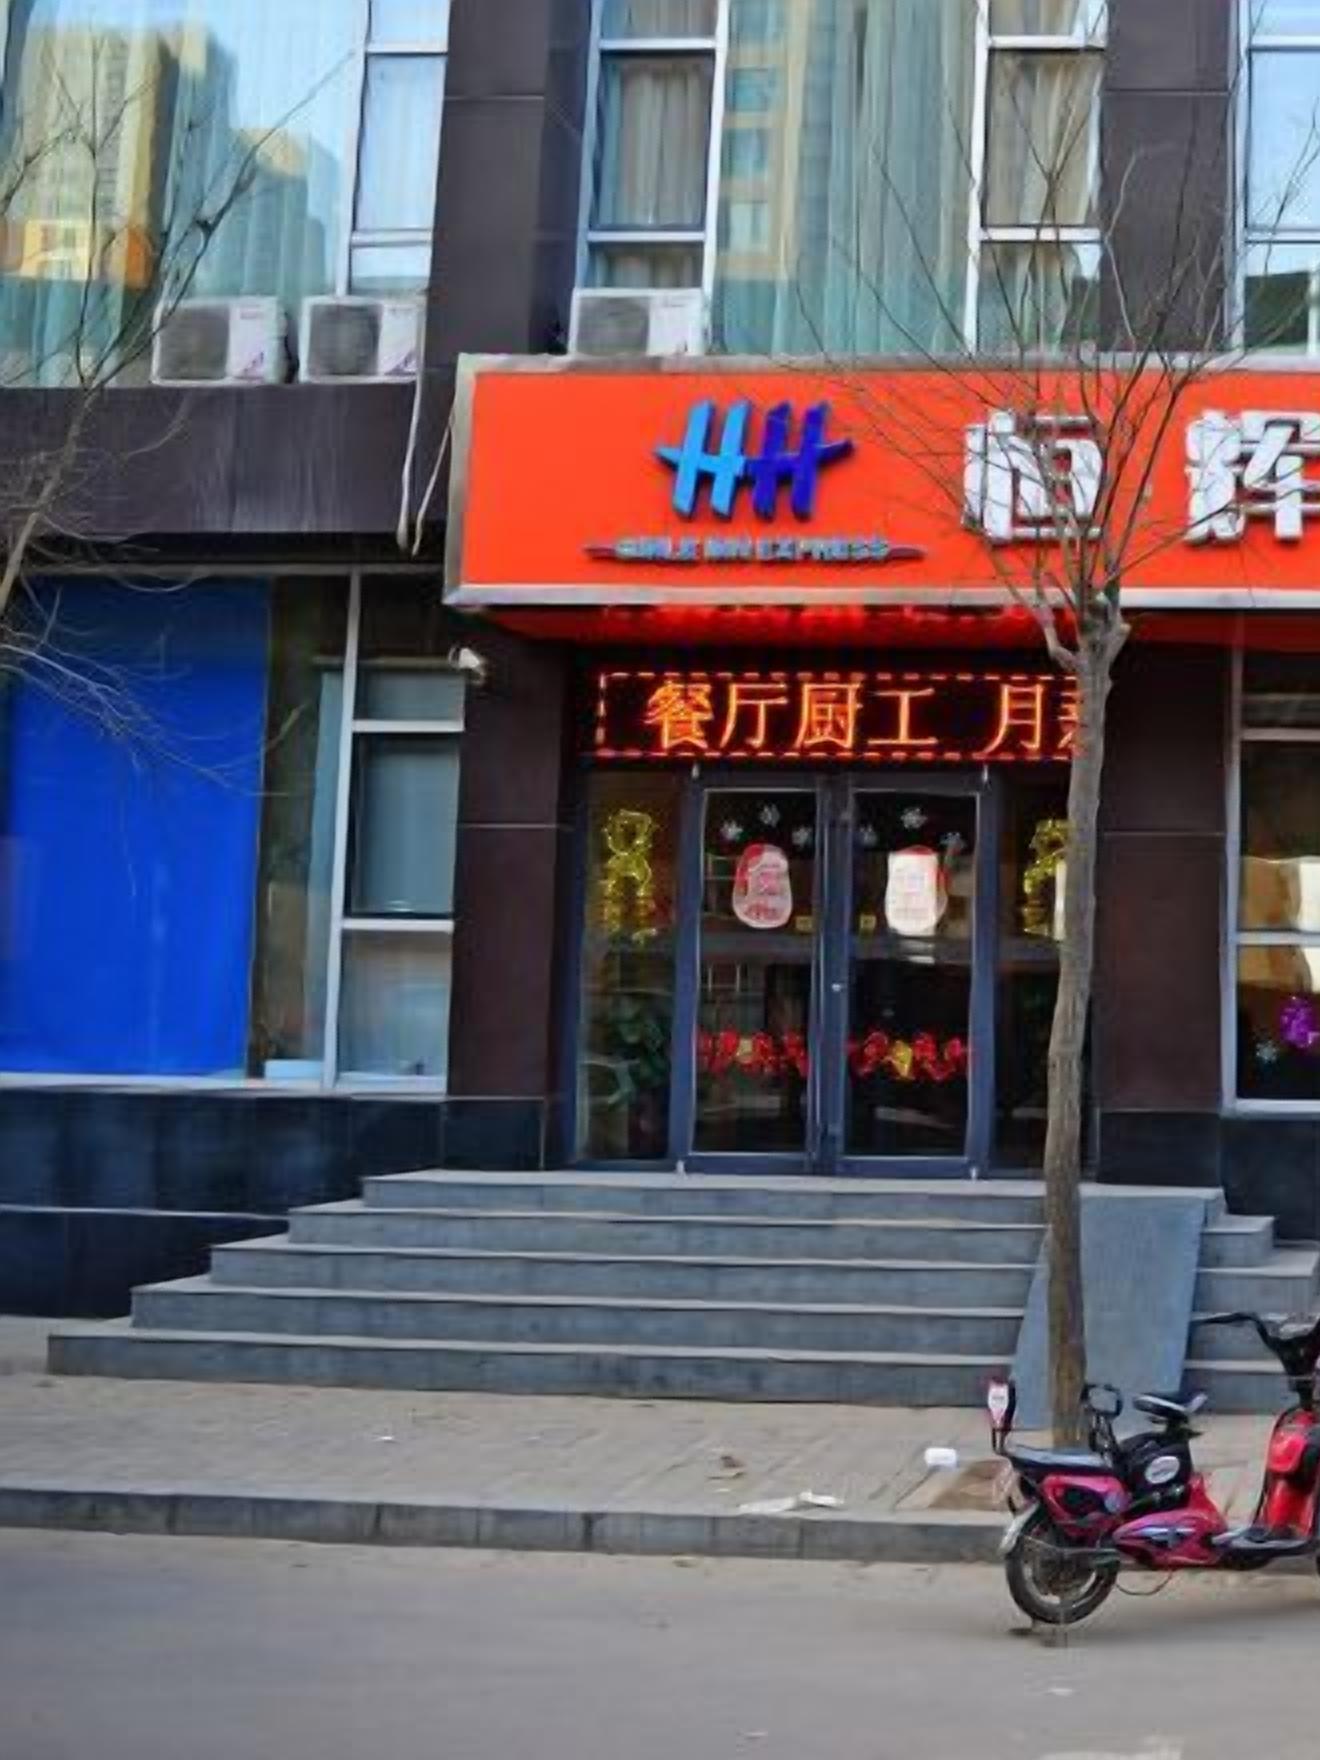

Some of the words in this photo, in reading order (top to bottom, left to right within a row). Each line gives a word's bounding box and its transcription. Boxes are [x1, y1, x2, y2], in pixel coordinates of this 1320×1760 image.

[755, 536, 890, 562] EXPRESS
[643, 679, 939, 750] 餐厅厨工
